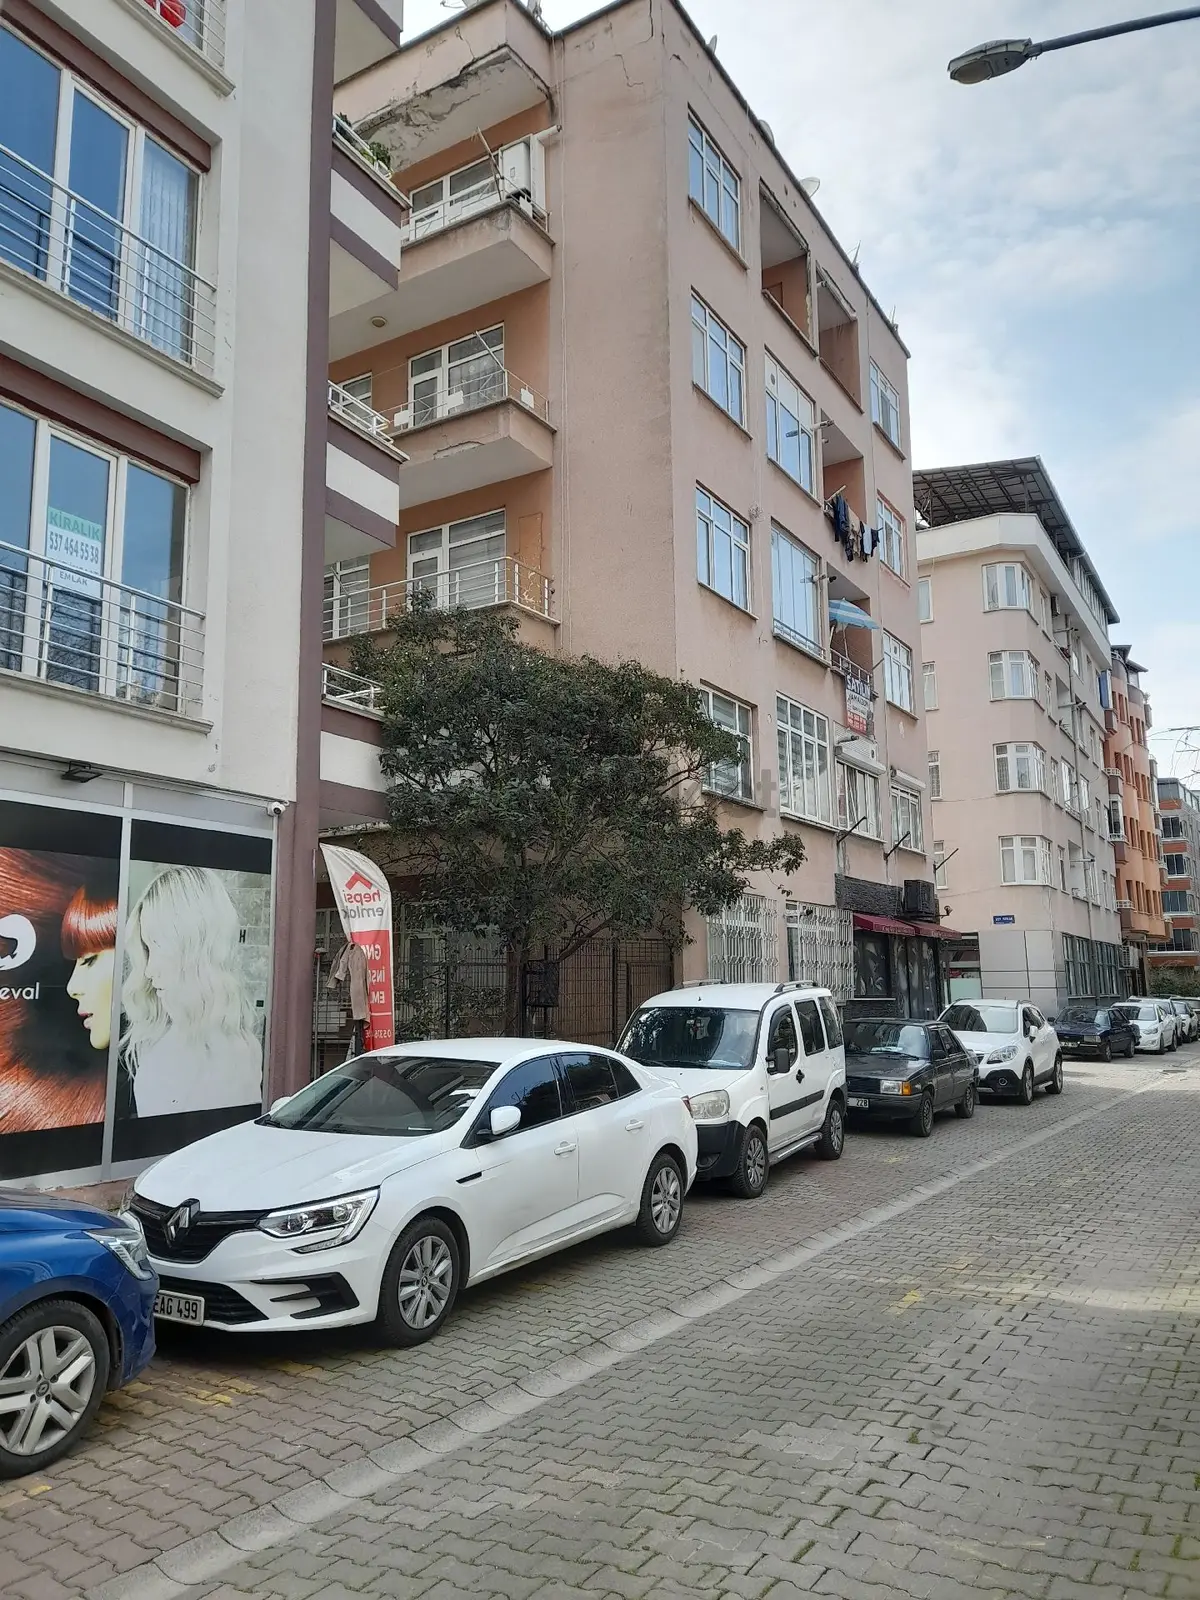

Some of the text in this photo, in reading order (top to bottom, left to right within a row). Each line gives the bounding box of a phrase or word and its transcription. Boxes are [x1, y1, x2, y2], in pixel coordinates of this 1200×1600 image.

[50, 511, 100, 541] KİRALIK
[49, 531, 63, 552] 537
[64, 537, 79, 557] 464
[60, 571, 88, 586] EMLAK
[153, 1295, 198, 1320] EAG 499
